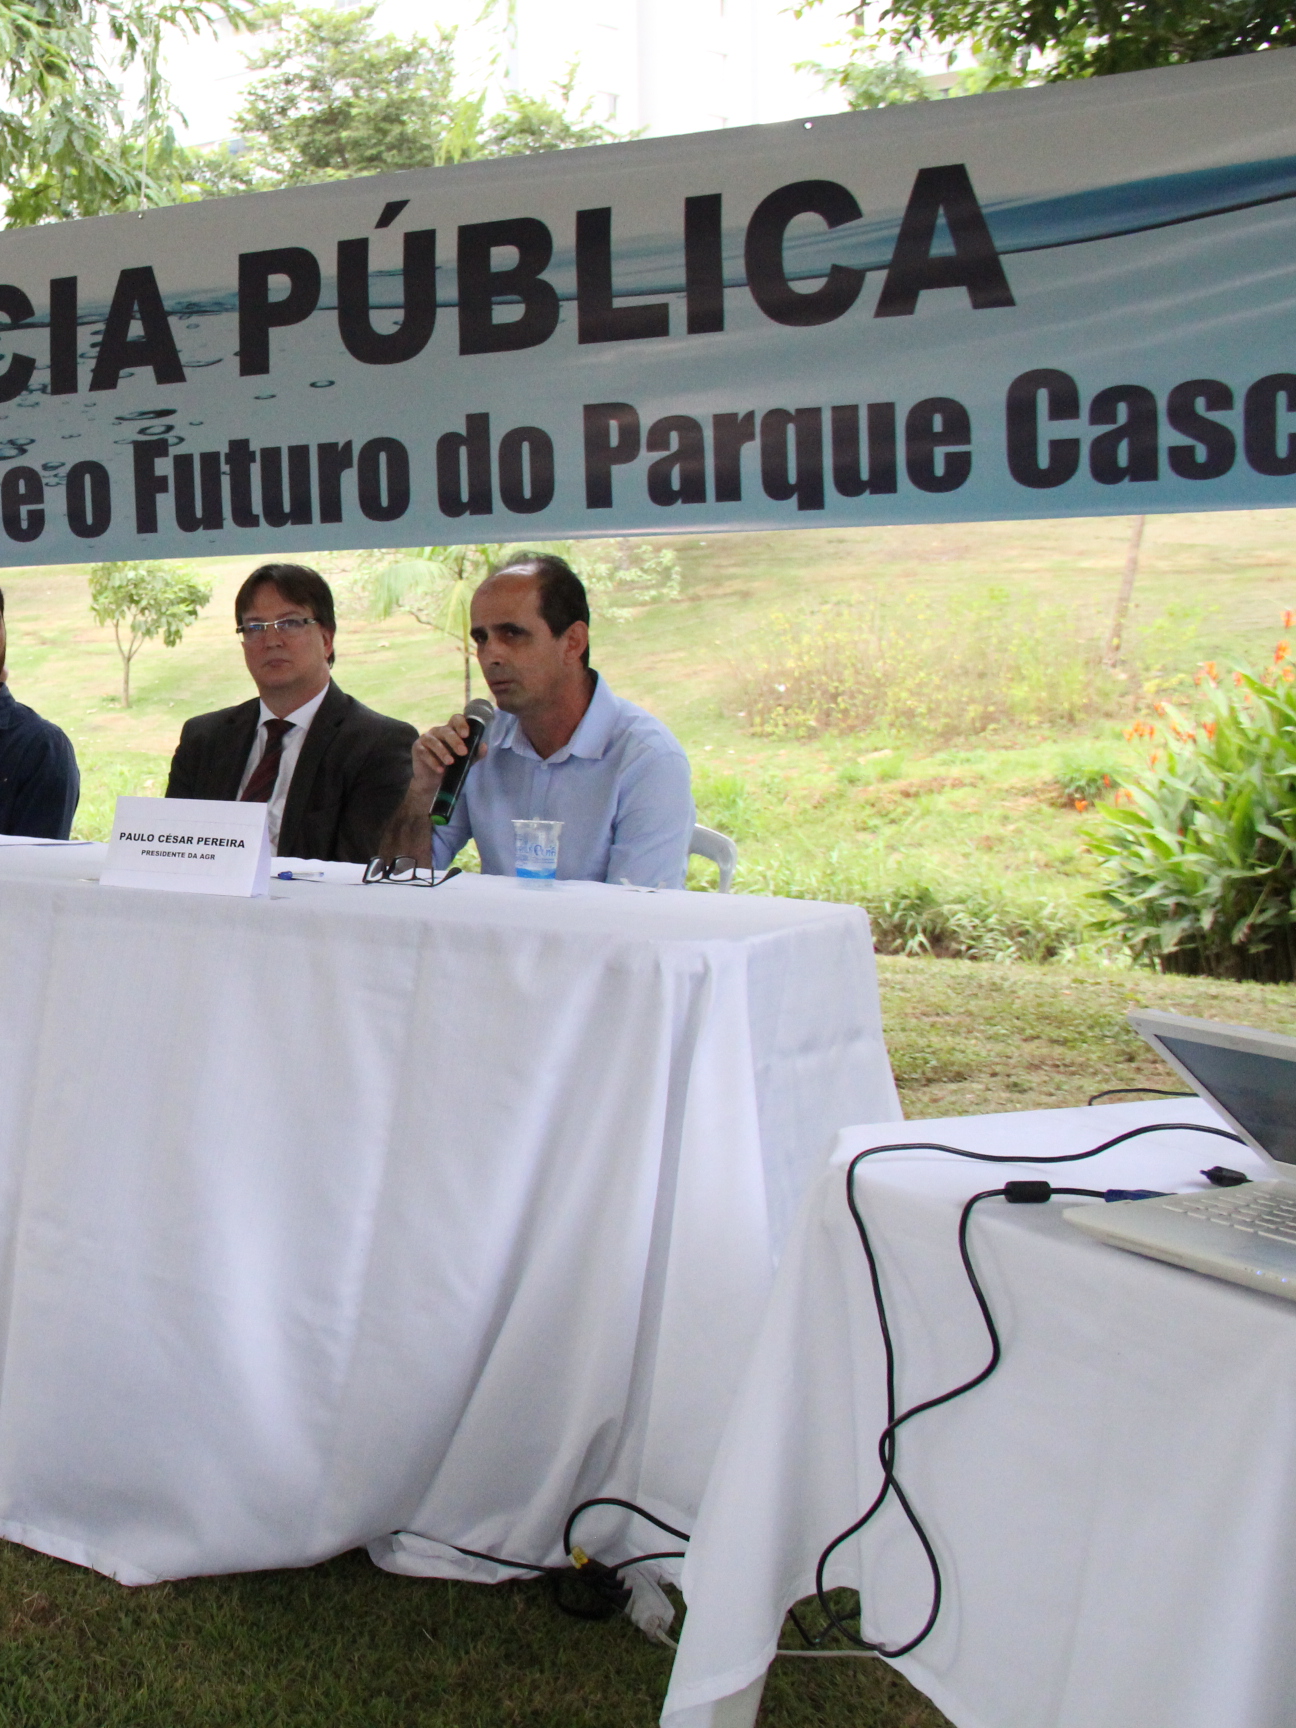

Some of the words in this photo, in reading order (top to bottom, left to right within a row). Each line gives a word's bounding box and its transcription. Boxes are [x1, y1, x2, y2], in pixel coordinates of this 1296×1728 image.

[238, 163, 1016, 377] PÚBLICA
[1, 465, 45, 542] e
[65, 460, 112, 539] o
[133, 438, 411, 534] Futuro
[436, 412, 556, 519] do
[583, 396, 972, 511] Parque
[1006, 368, 1296, 489] Casc
[119, 832, 155, 843] PAULO
[157, 833, 194, 845] CÉSAR
[196, 836, 246, 849] PEREIRA
[141, 849, 186, 859] PRESIDENTE
[187, 852, 198, 860] DA
[199, 853, 216, 861] AGR
